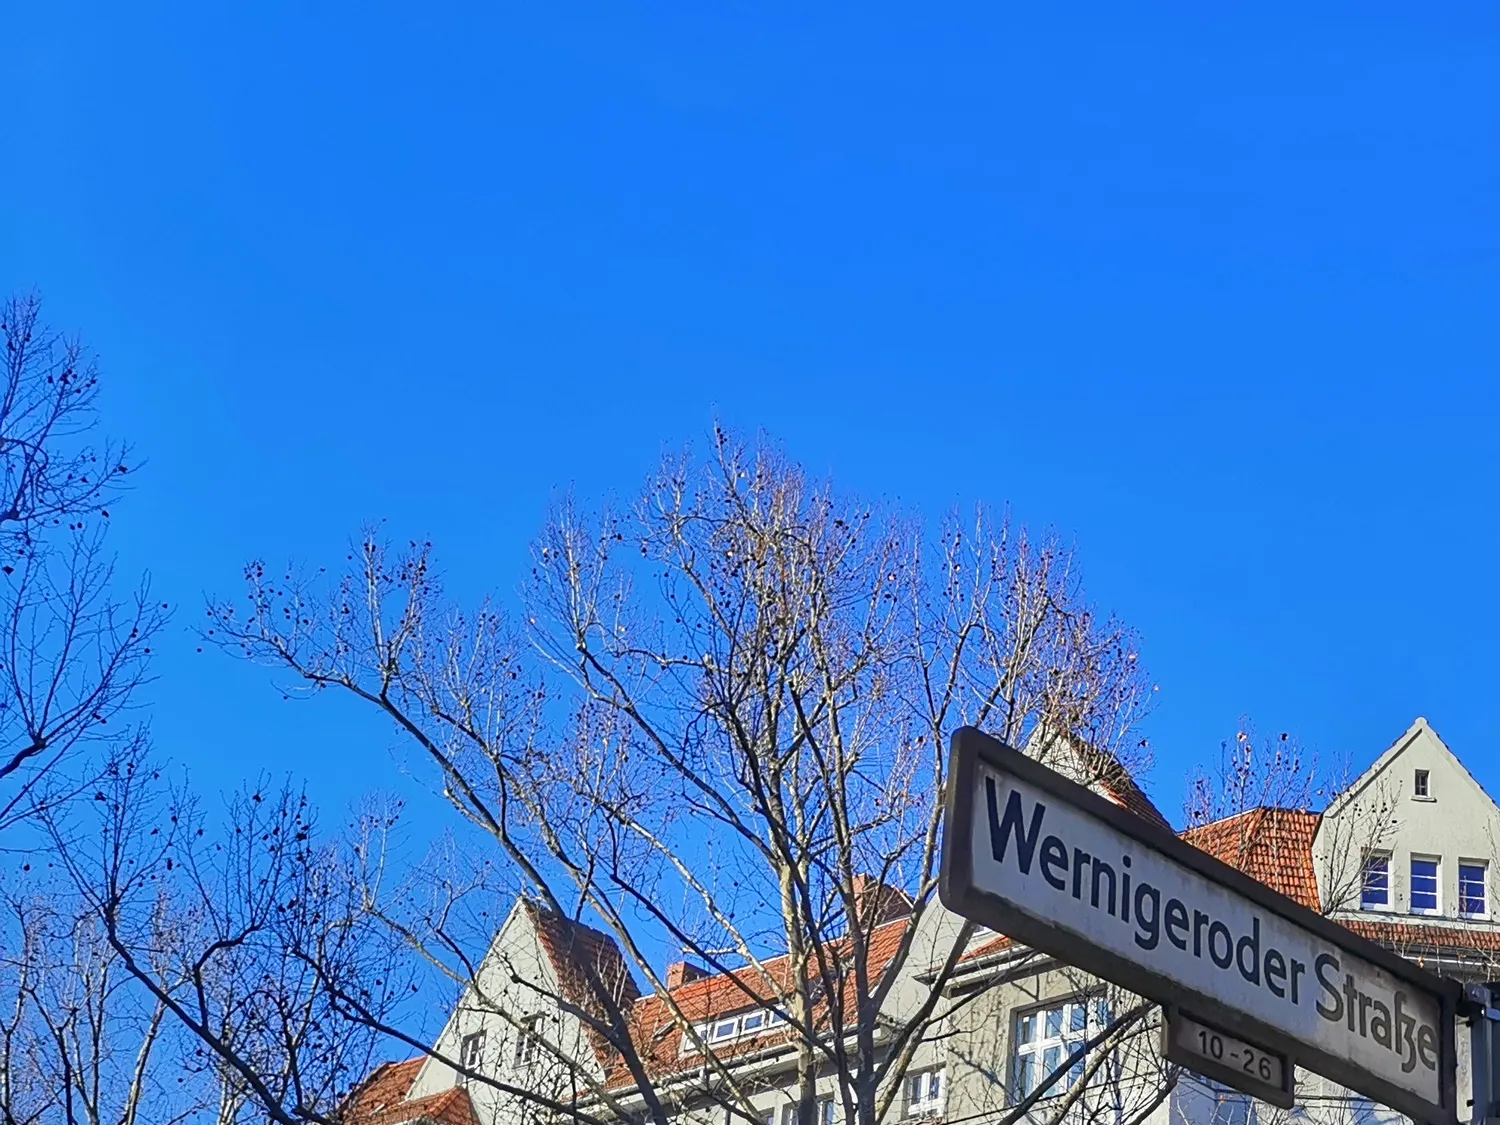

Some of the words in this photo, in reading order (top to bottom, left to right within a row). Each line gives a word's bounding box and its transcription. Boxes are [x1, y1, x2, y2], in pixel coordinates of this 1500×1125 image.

[985, 776, 1305, 1005] Wernigeroder
[1314, 952, 1437, 1074] Straße
[1198, 1030, 1273, 1082] 10-26
